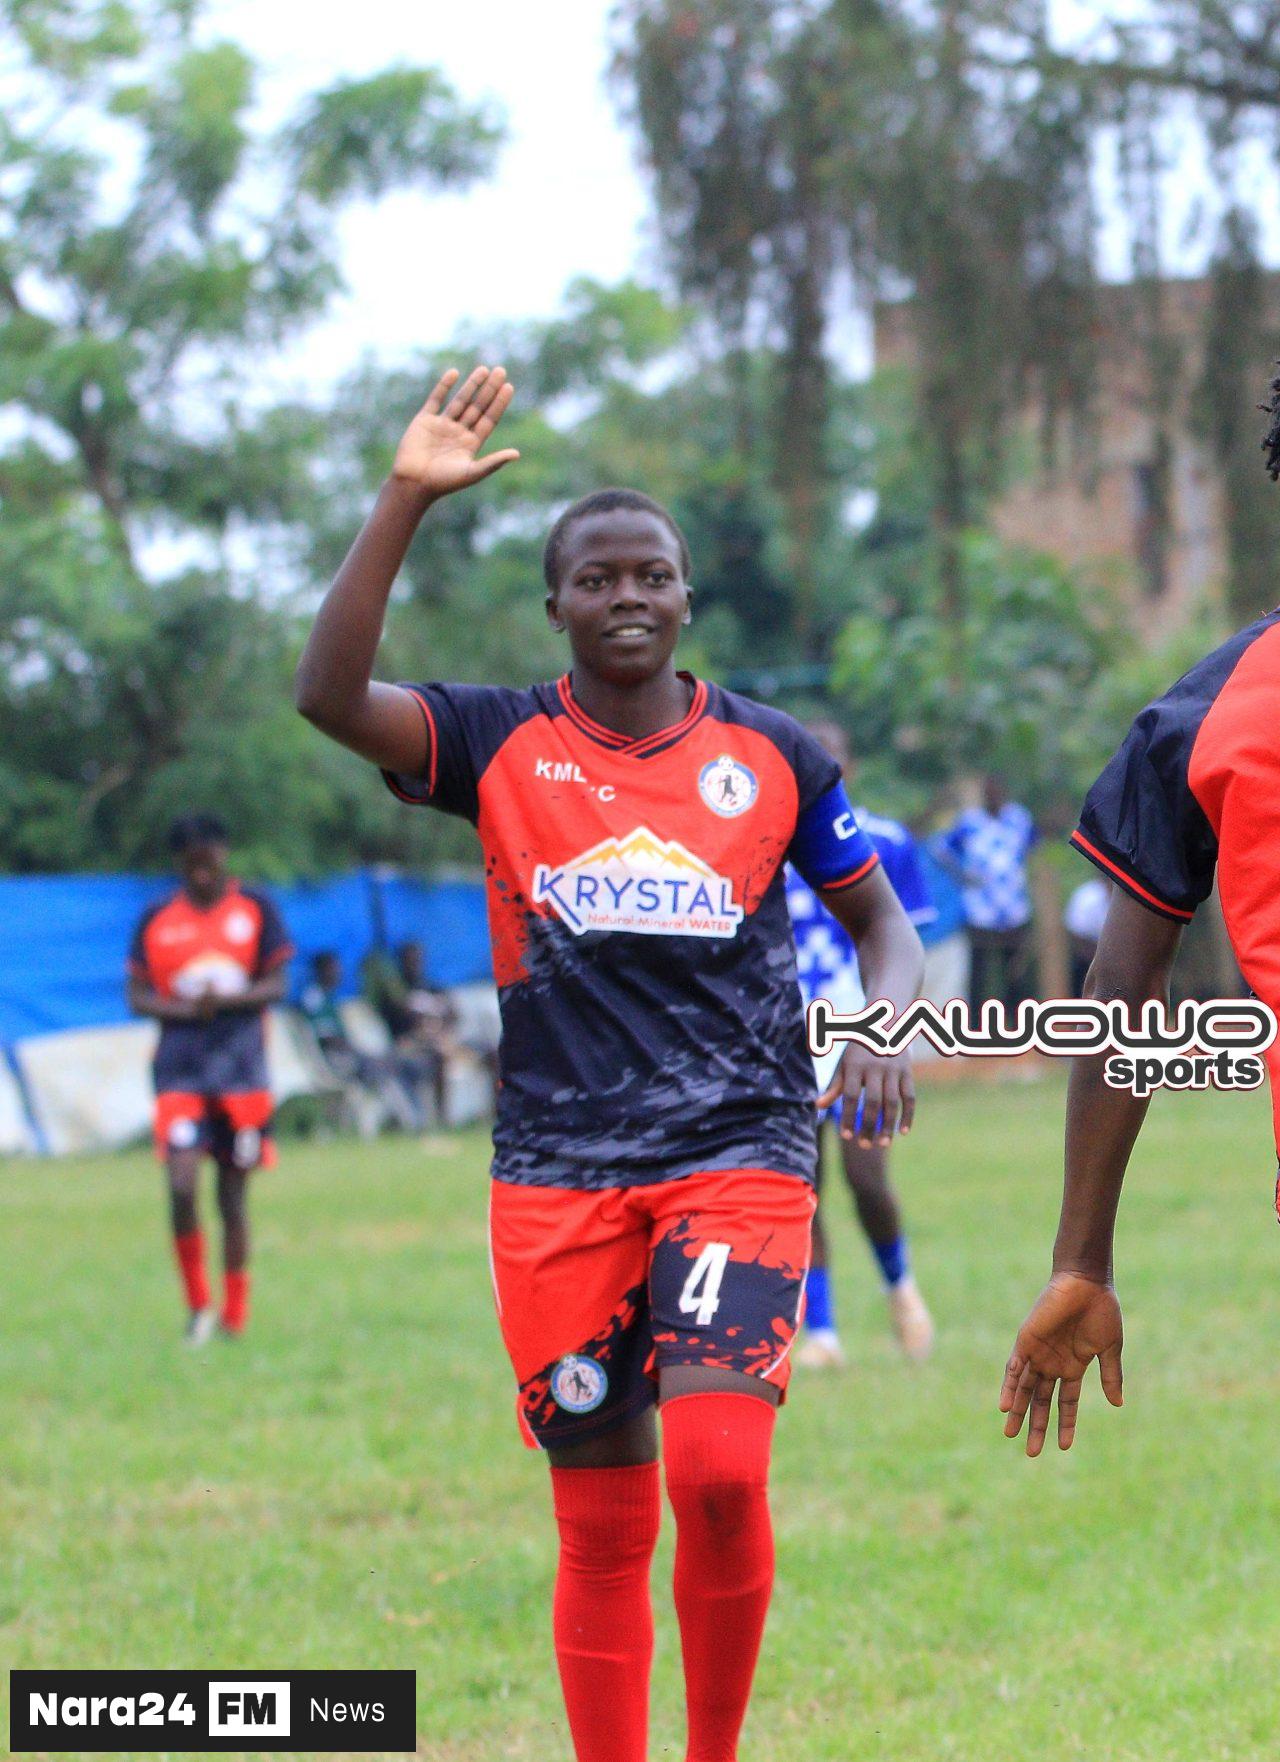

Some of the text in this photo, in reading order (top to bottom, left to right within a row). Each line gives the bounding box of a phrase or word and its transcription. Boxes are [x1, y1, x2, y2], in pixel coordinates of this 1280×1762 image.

[832, 812, 858, 841] C
[539, 870, 738, 928] KRYSTAL
[688, 917, 731, 931] WATER
[678, 1242, 731, 1326] 4
